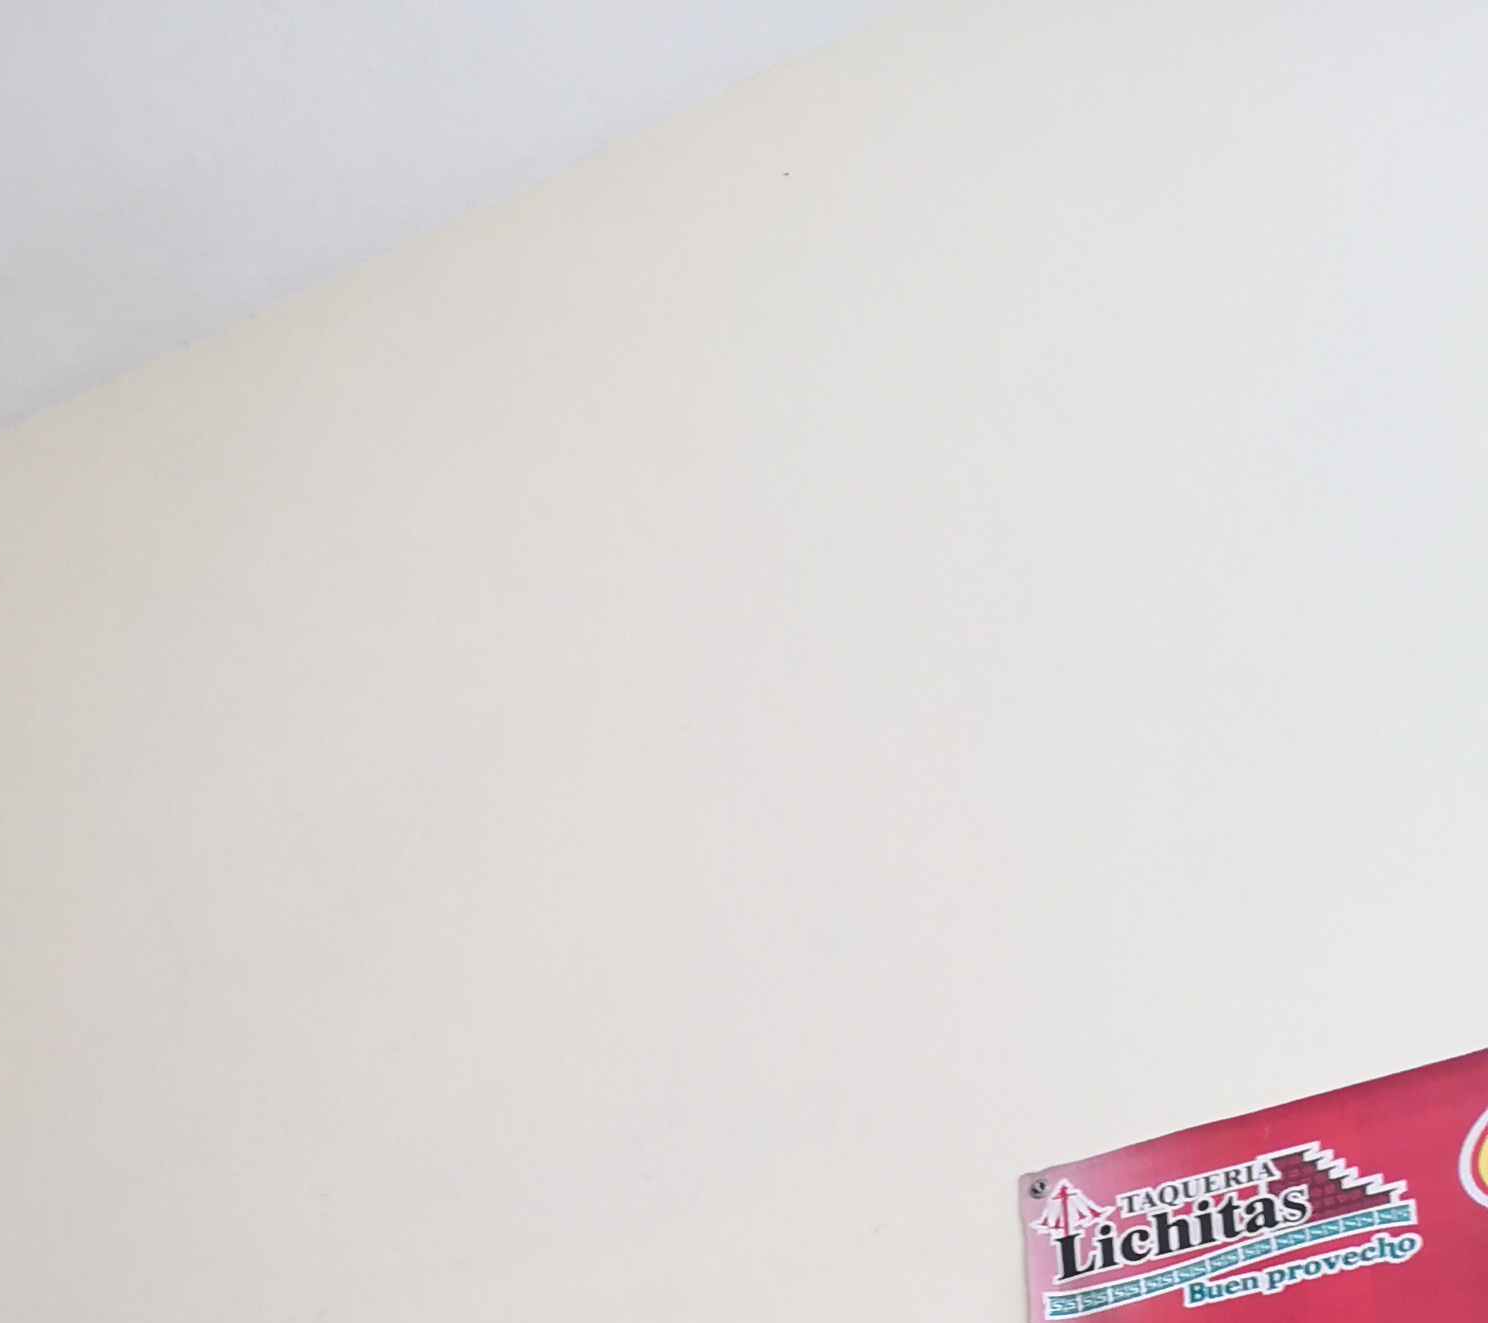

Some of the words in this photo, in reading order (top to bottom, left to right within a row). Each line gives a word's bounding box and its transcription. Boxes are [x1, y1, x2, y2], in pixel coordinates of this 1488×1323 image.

[1121, 1159, 1279, 1216] TAQUERIA
[1056, 1187, 1309, 1281] Lichitas
[1188, 1272, 1269, 1304] Buen
[1268, 1236, 1417, 1292] provecho
